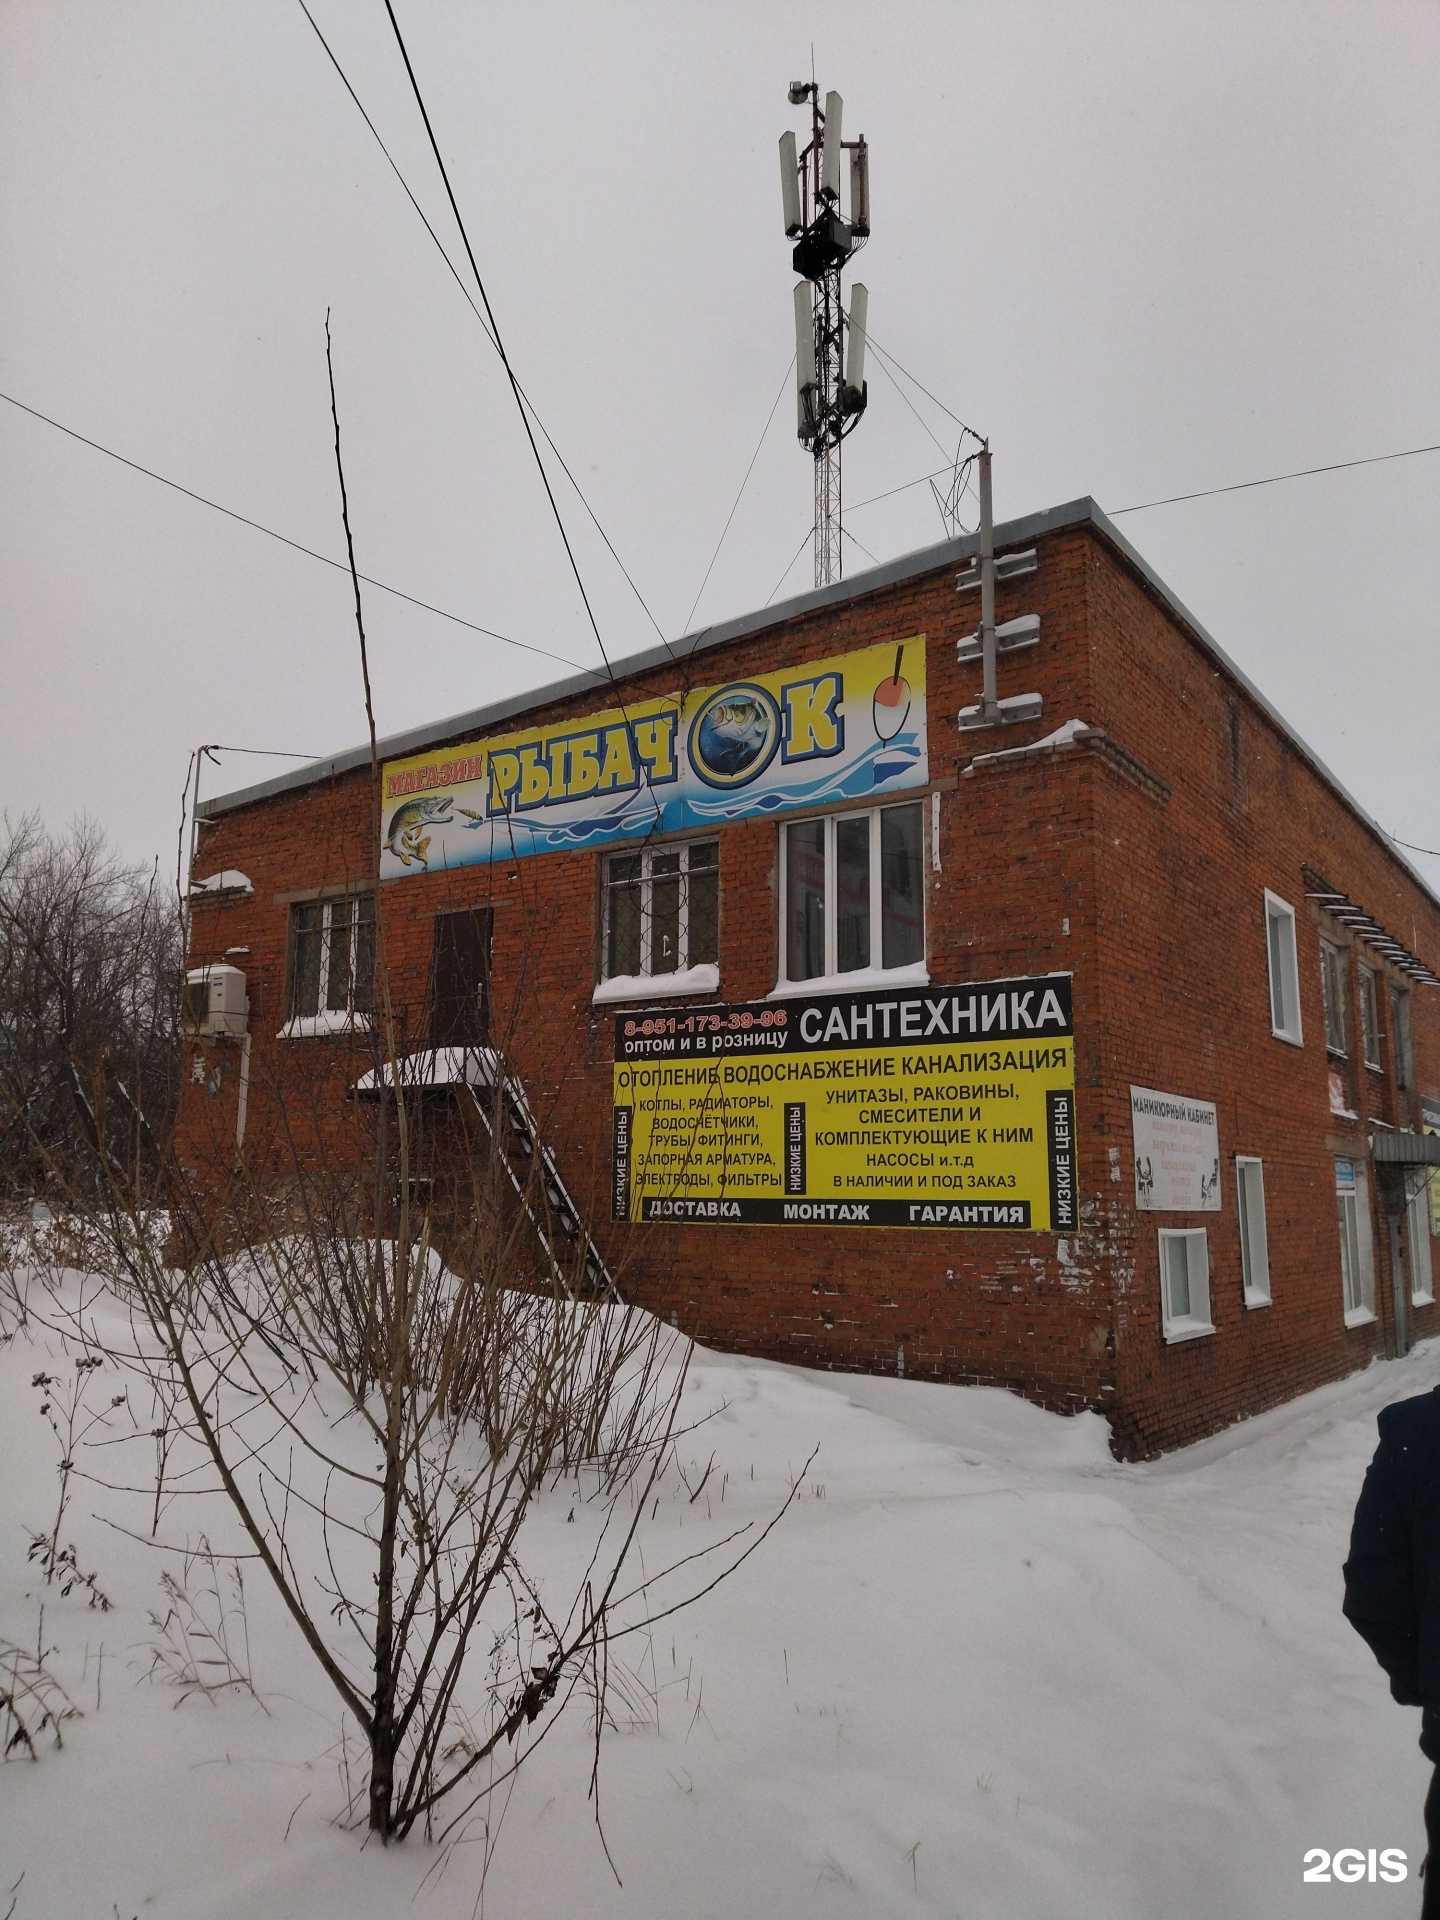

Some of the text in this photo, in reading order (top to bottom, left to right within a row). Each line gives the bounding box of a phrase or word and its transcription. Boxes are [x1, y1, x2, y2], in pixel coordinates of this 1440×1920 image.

[386, 756, 482, 798] МАГАЗИН
[624, 1010, 788, 1036] 8-951-173-39-96
[799, 989, 1068, 1044] САНТЕХНИКА
[624, 1030, 789, 1054] оптом и в розницу
[618, 1047, 1067, 1088] ОТОПЛЕНИЕ ВОДОСНАБЖЕНИЕ КАНАЛИЗАЦИЯ
[639, 1095, 774, 1112] КОТЛЫ, РАДИАТОРЫ,
[826, 1083, 1020, 1105] УНИТАЗЫ, РАКОВИНЫ,
[859, 1106, 981, 1124] СМЕСИТЕЛИ И
[1133, 1097, 1216, 1126] МАНИКЮРНЫЙ КАБИНЕТ
[652, 1113, 759, 1131] ВОДОСЧЁТЧИКИ,
[617, 1111, 629, 1154] ЦЕНЫ
[698, 1133, 763, 1147] ФИТИНГИ,
[815, 1127, 1034, 1147] КОМПЛЕКТУЮЩИЕ К НИМ
[789, 1106, 803, 1191] НИЗКИЕ ЦЕНЫ
[638, 1151, 776, 1167] ЗАПОРНАЯ АРМАТУРА,
[866, 1152, 975, 1168] НАСОСЫ и.т.д
[1055, 1096, 1072, 1225] НИЗКИЕ ЦЕНЫ
[635, 1172, 782, 1188] ЭЛЕКТРОДЫ, ФИЛЬТРЫ
[833, 1174, 1017, 1190] В НАЛИЧИИ И ПОД ЗАКАЗ
[649, 1200, 742, 1218] ДОСТАВКА
[783, 1203, 871, 1221] МОНТАЖ
[909, 1204, 1025, 1223] ГАРАНТИЯ
